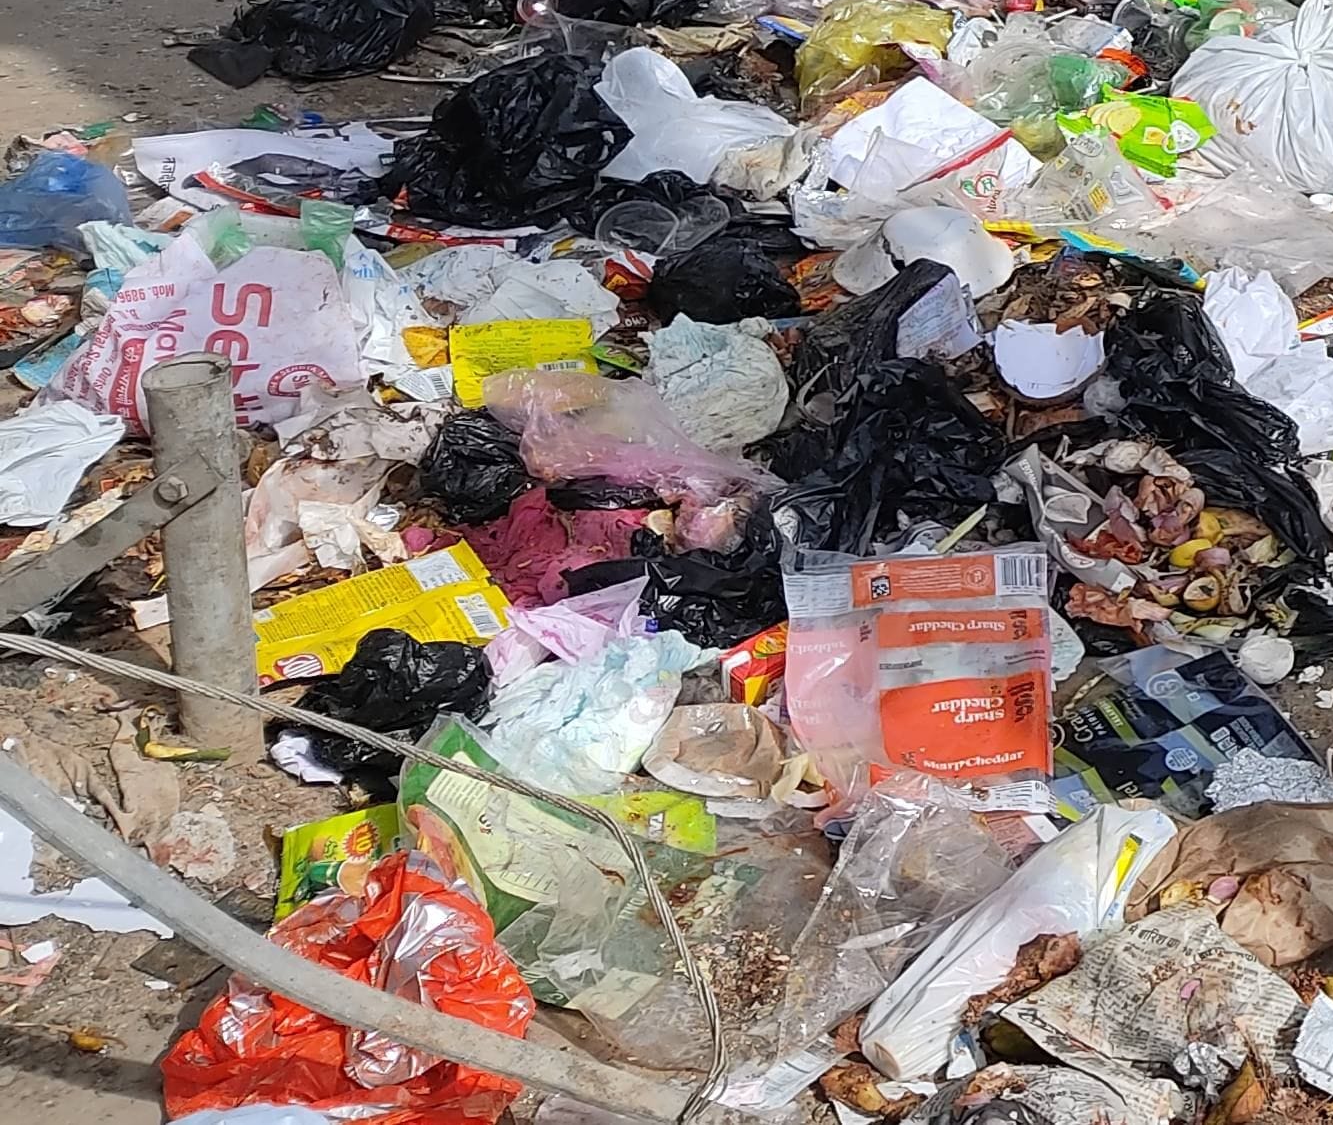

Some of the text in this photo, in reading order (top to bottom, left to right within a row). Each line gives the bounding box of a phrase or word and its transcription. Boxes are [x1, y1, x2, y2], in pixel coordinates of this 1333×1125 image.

[908, 619, 1006, 632] Sharp Cheddar
[931, 697, 1005, 713] Cheddar
[953, 708, 1005, 724] Sharp
[962, 749, 1025, 767] Cheddar
